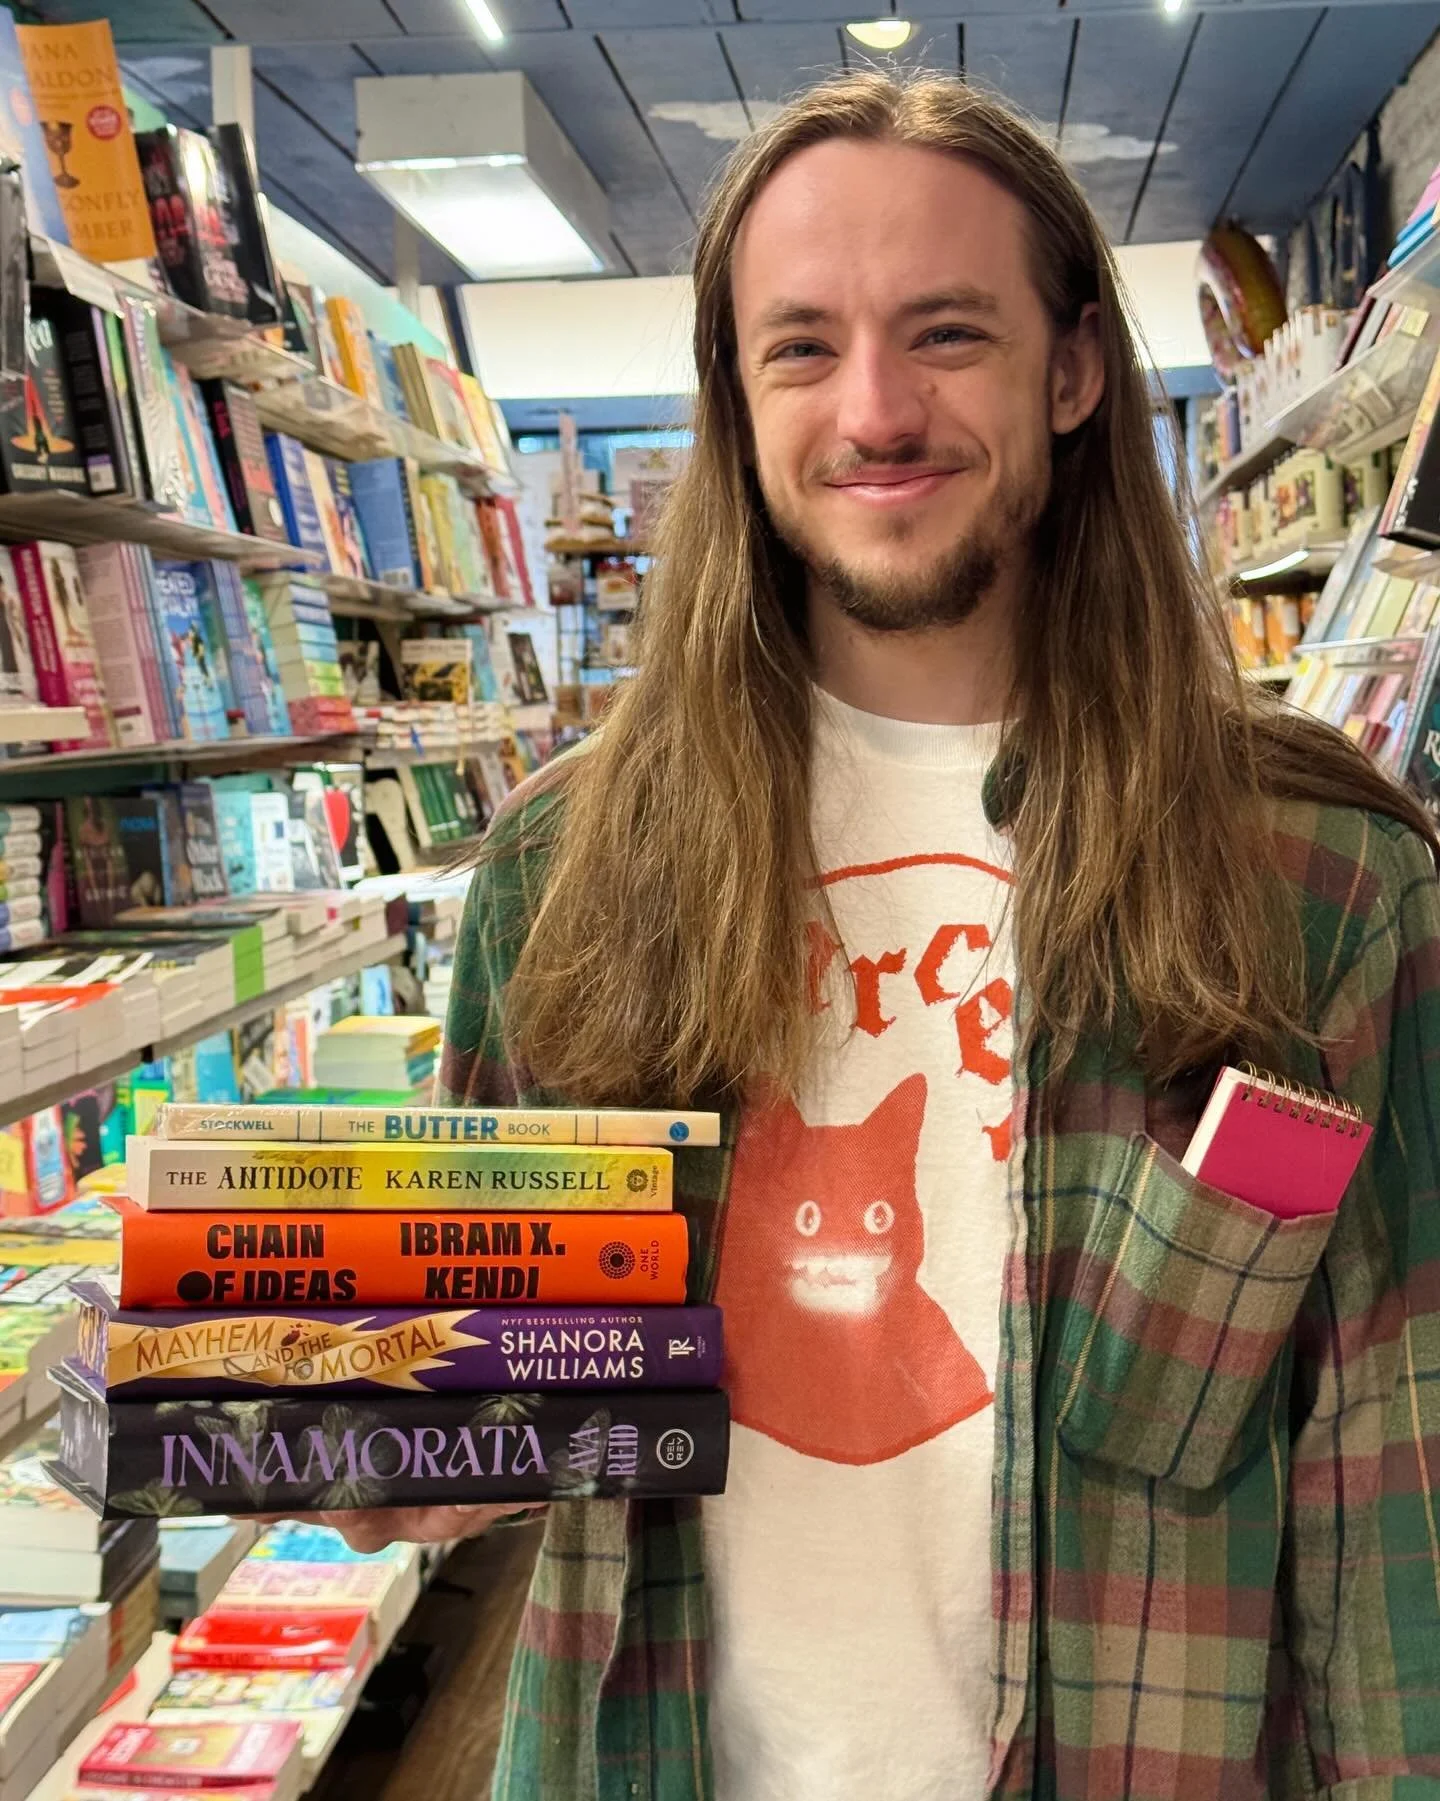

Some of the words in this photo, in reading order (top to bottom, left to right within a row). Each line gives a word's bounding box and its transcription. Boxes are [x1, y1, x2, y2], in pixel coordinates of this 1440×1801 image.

[199, 1119, 274, 1131] STOCKWELL
[348, 1120, 375, 1133] THE
[383, 1114, 499, 1140] BUTTER
[507, 1123, 550, 1136] BOOK
[166, 1171, 208, 1186] THE
[217, 1165, 363, 1190] ANTIDOTE
[386, 1169, 483, 1190] KAREN
[491, 1170, 611, 1191] RUSSELL
[650, 1165, 658, 1198] Vintage
[206, 1223, 324, 1259] CHAIN
[399, 1222, 522, 1257] IBRAM
[528, 1222, 566, 1256] X.
[640, 1247, 649, 1273] ONE
[650, 1239, 660, 1281] WORLD
[243, 1268, 357, 1302] IDEAS
[424, 1265, 540, 1300] KENDI
[526, 1317, 595, 1326] BESTSELLING
[600, 1316, 643, 1325] AUTHOR
[135, 1320, 276, 1373] MAYHEM
[251, 1345, 295, 1371] AND
[300, 1331, 332, 1357] THE
[319, 1318, 447, 1382] MORTAL
[500, 1328, 645, 1355] SHANORA
[507, 1356, 644, 1382] WILLIAMS
[160, 1424, 549, 1488] INNAMORATA
[567, 1426, 600, 1477] AVA
[606, 1424, 639, 1476] REID
[667, 1438, 676, 1461] DEL
[676, 1436, 685, 1461] REY
